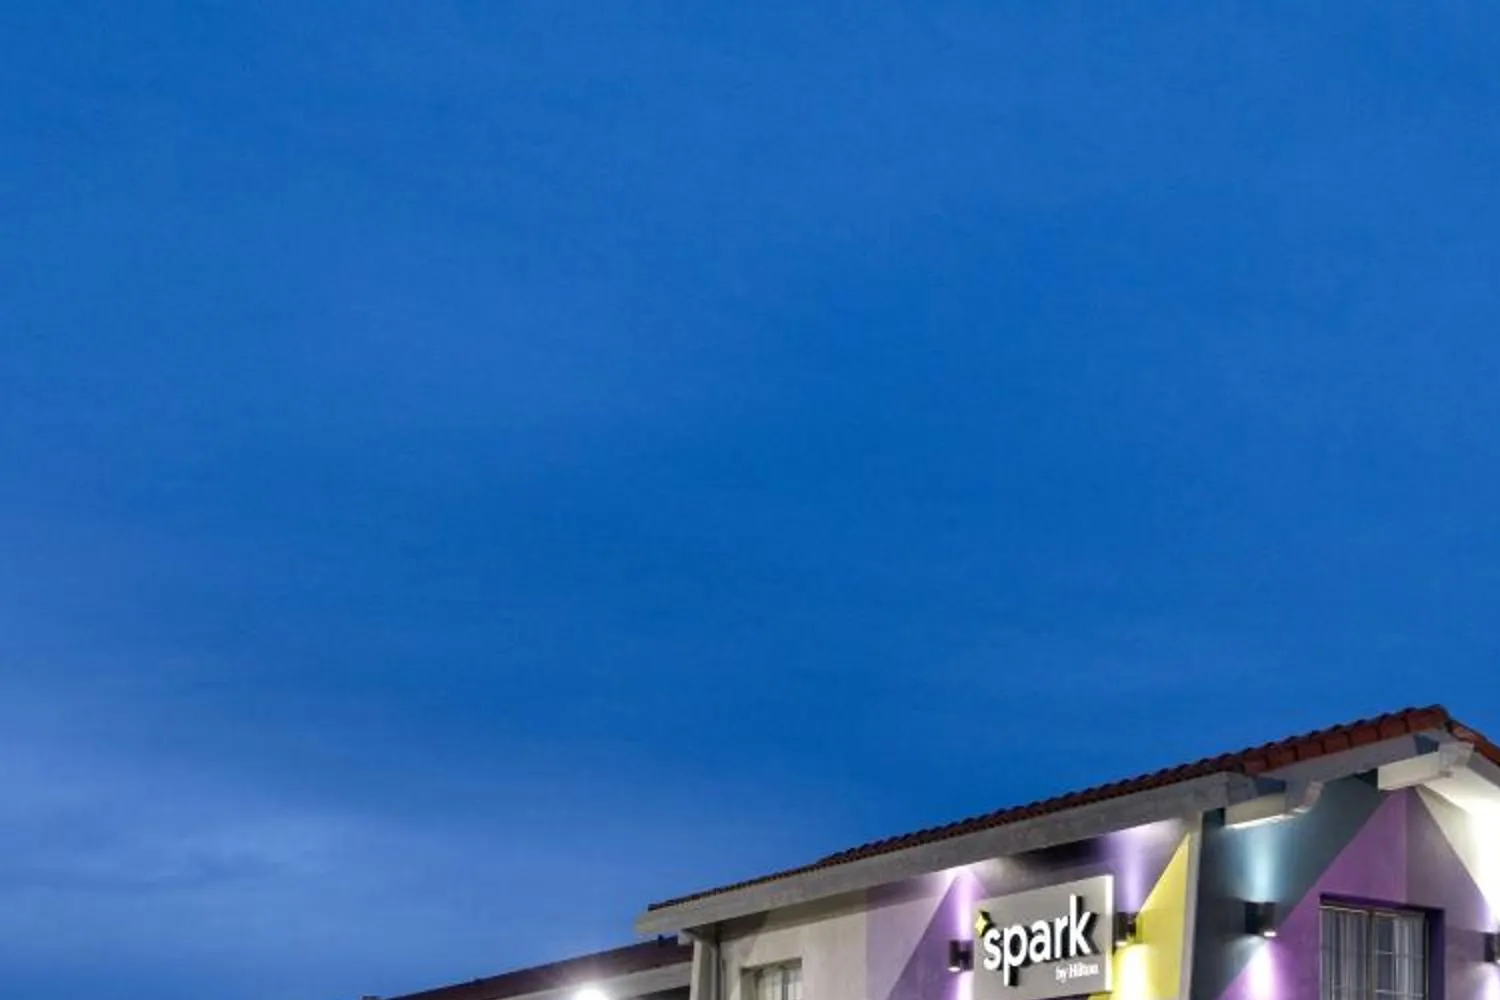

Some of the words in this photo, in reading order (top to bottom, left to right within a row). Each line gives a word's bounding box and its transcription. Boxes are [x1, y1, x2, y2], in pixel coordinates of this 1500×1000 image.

[983, 894, 1091, 986] spark
[1055, 966, 1067, 984] by
[1068, 962, 1099, 979] Hilton
